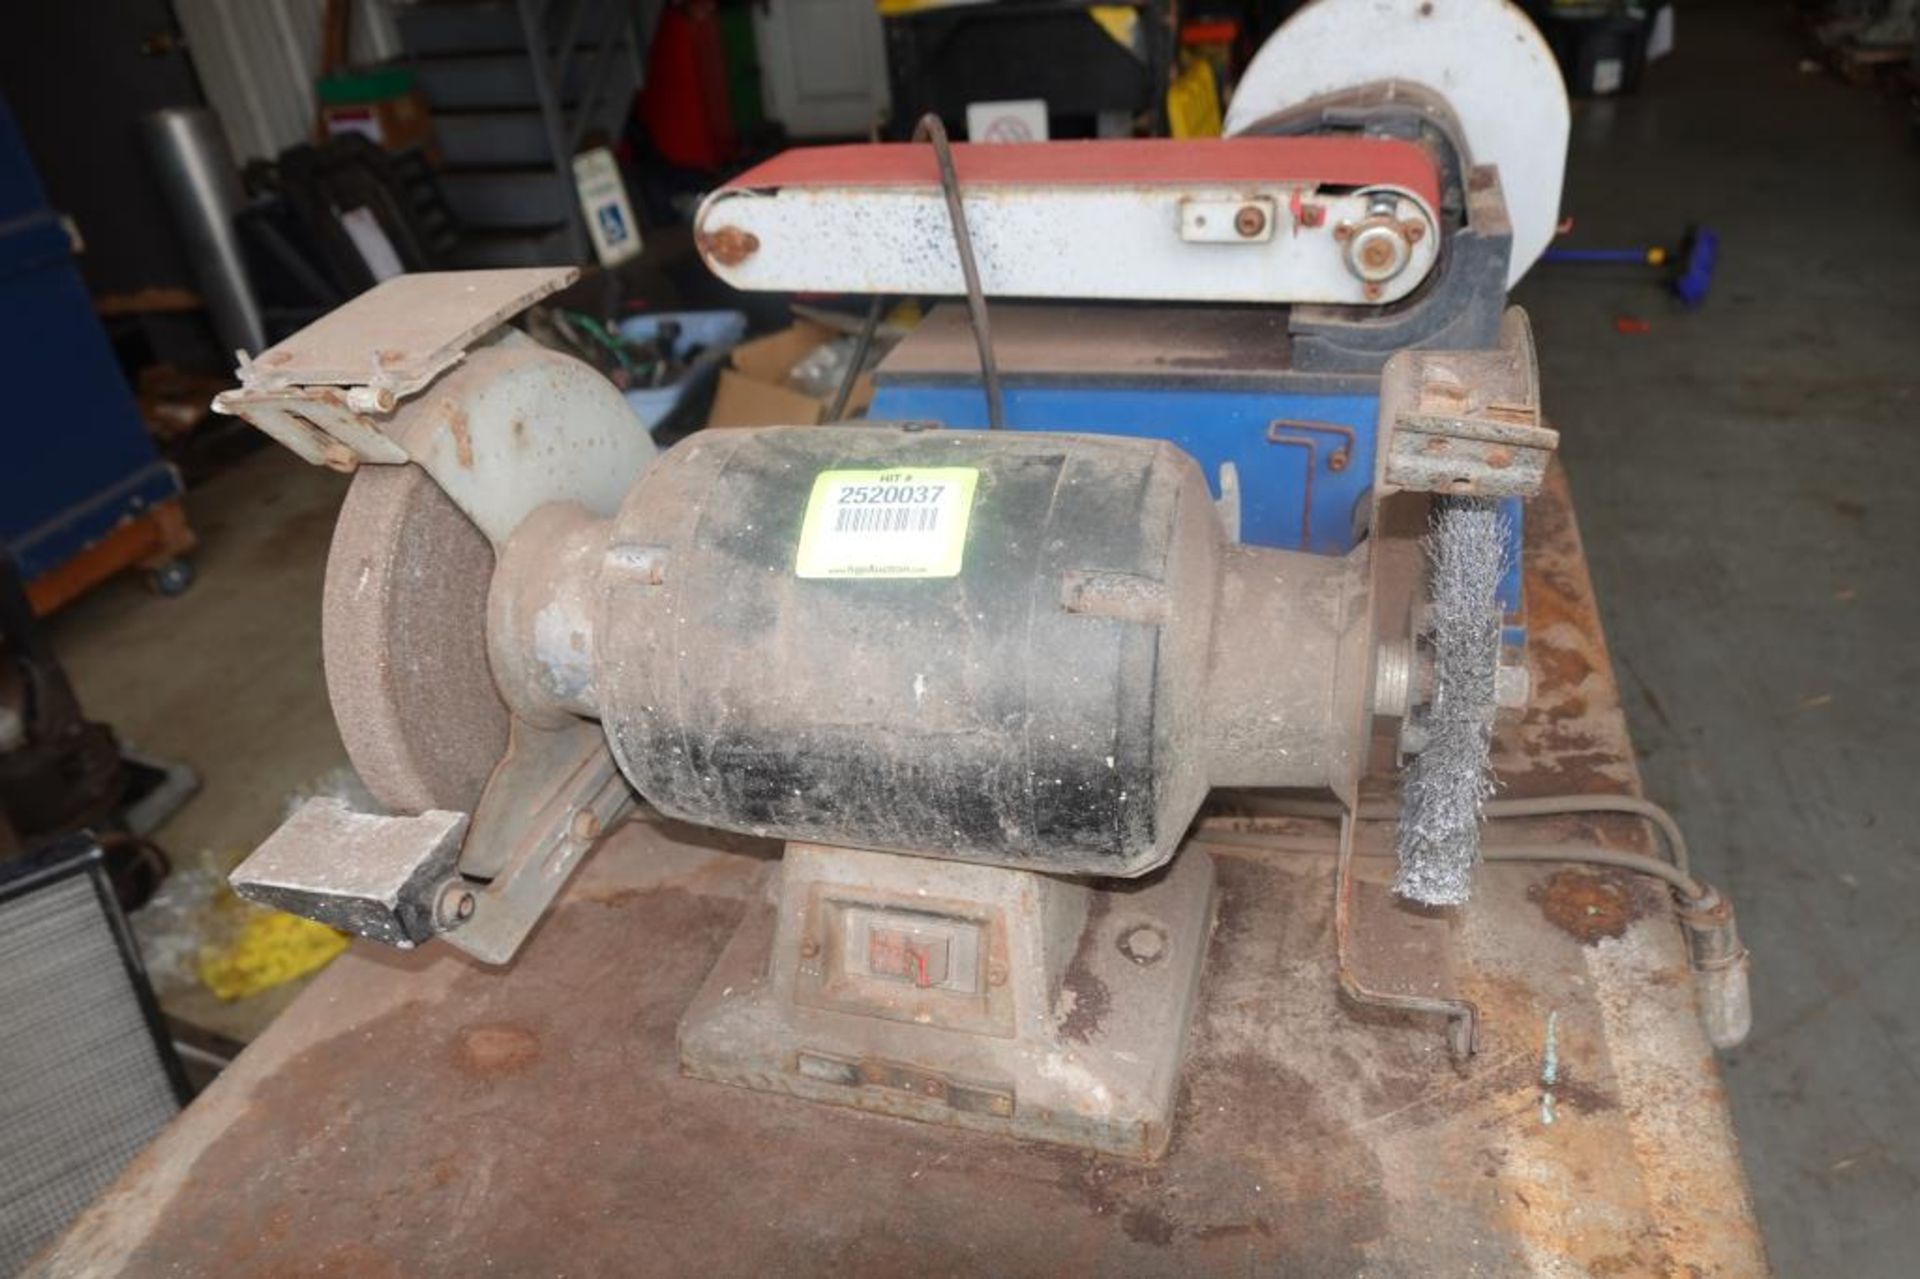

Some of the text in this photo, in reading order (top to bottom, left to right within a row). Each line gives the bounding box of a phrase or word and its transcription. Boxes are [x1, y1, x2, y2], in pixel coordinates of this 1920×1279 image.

[879, 473, 913, 482] HIT #
[838, 485, 945, 504] 2520037
